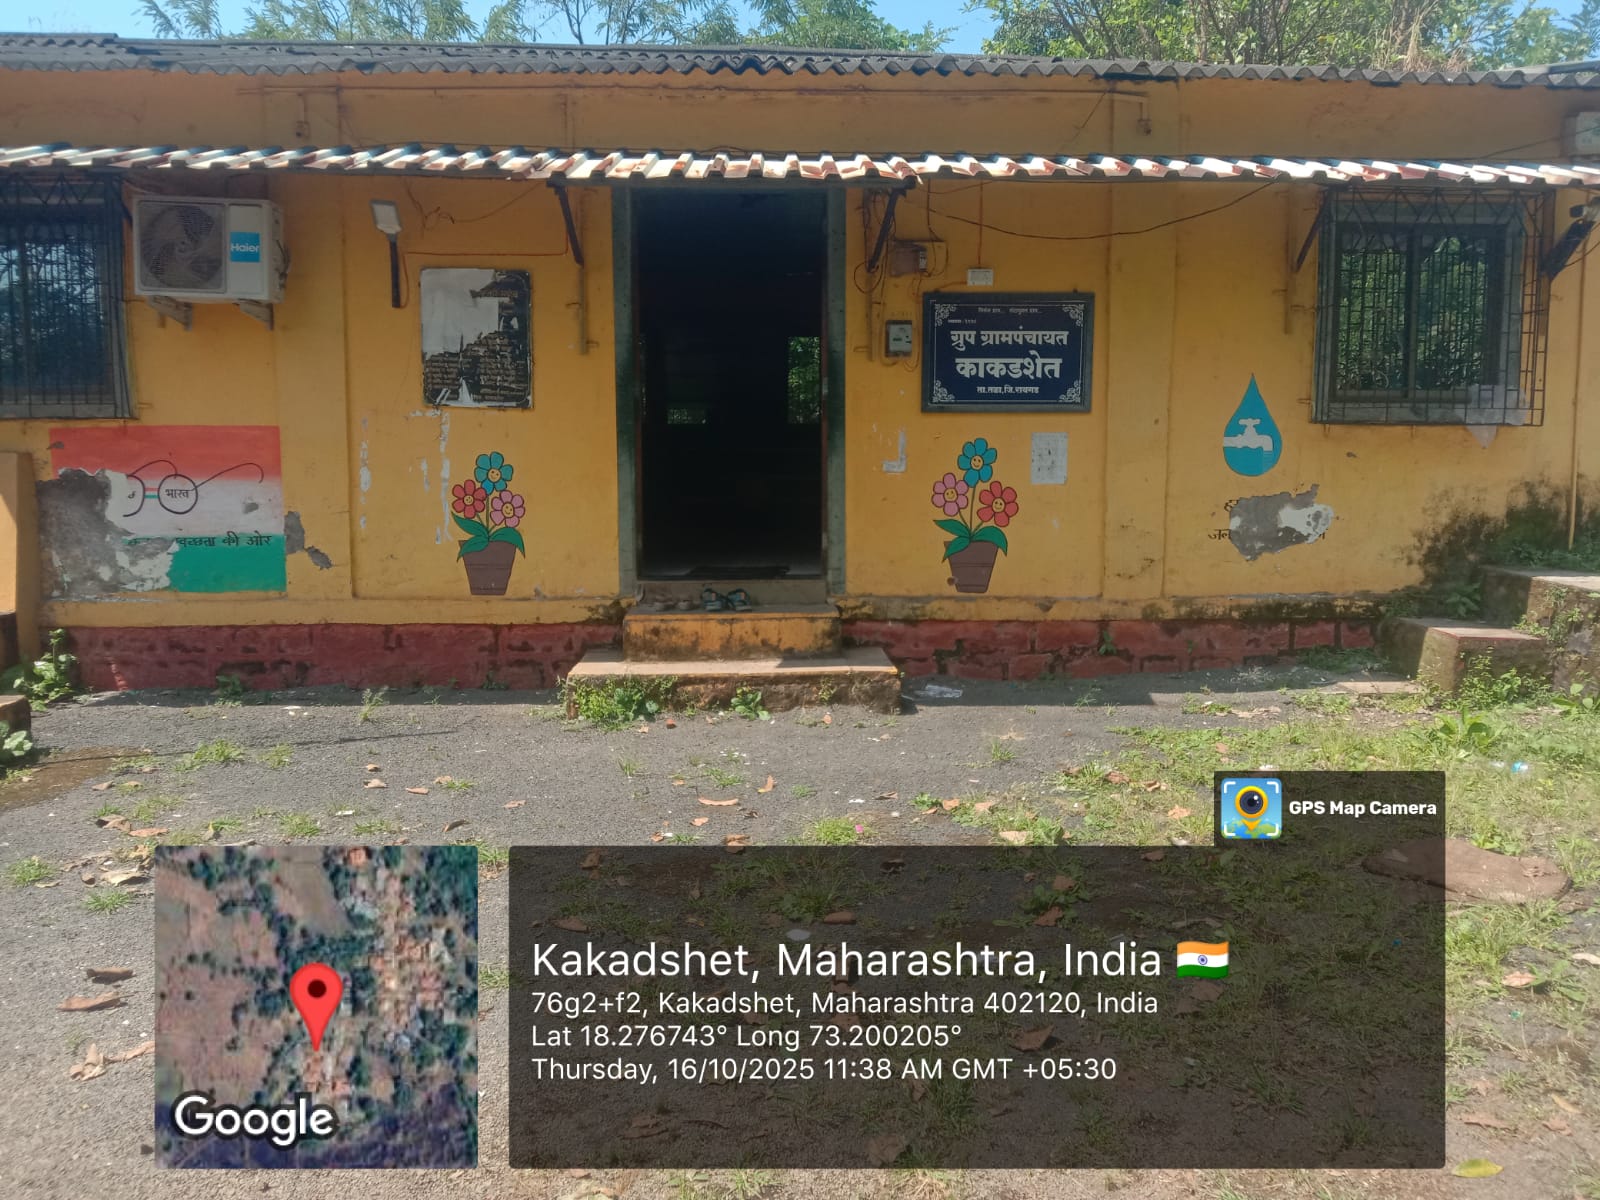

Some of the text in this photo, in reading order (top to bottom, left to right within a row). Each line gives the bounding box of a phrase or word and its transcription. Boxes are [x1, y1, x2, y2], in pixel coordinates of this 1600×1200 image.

[231, 242, 260, 253] Haier
[950, 325, 1069, 351] ग्रुप ग्रामपंचायत
[955, 350, 1063, 380] काकडशेत
[165, 488, 190, 499] भारत
[222, 530, 239, 546] की
[246, 530, 272, 546] ओर
